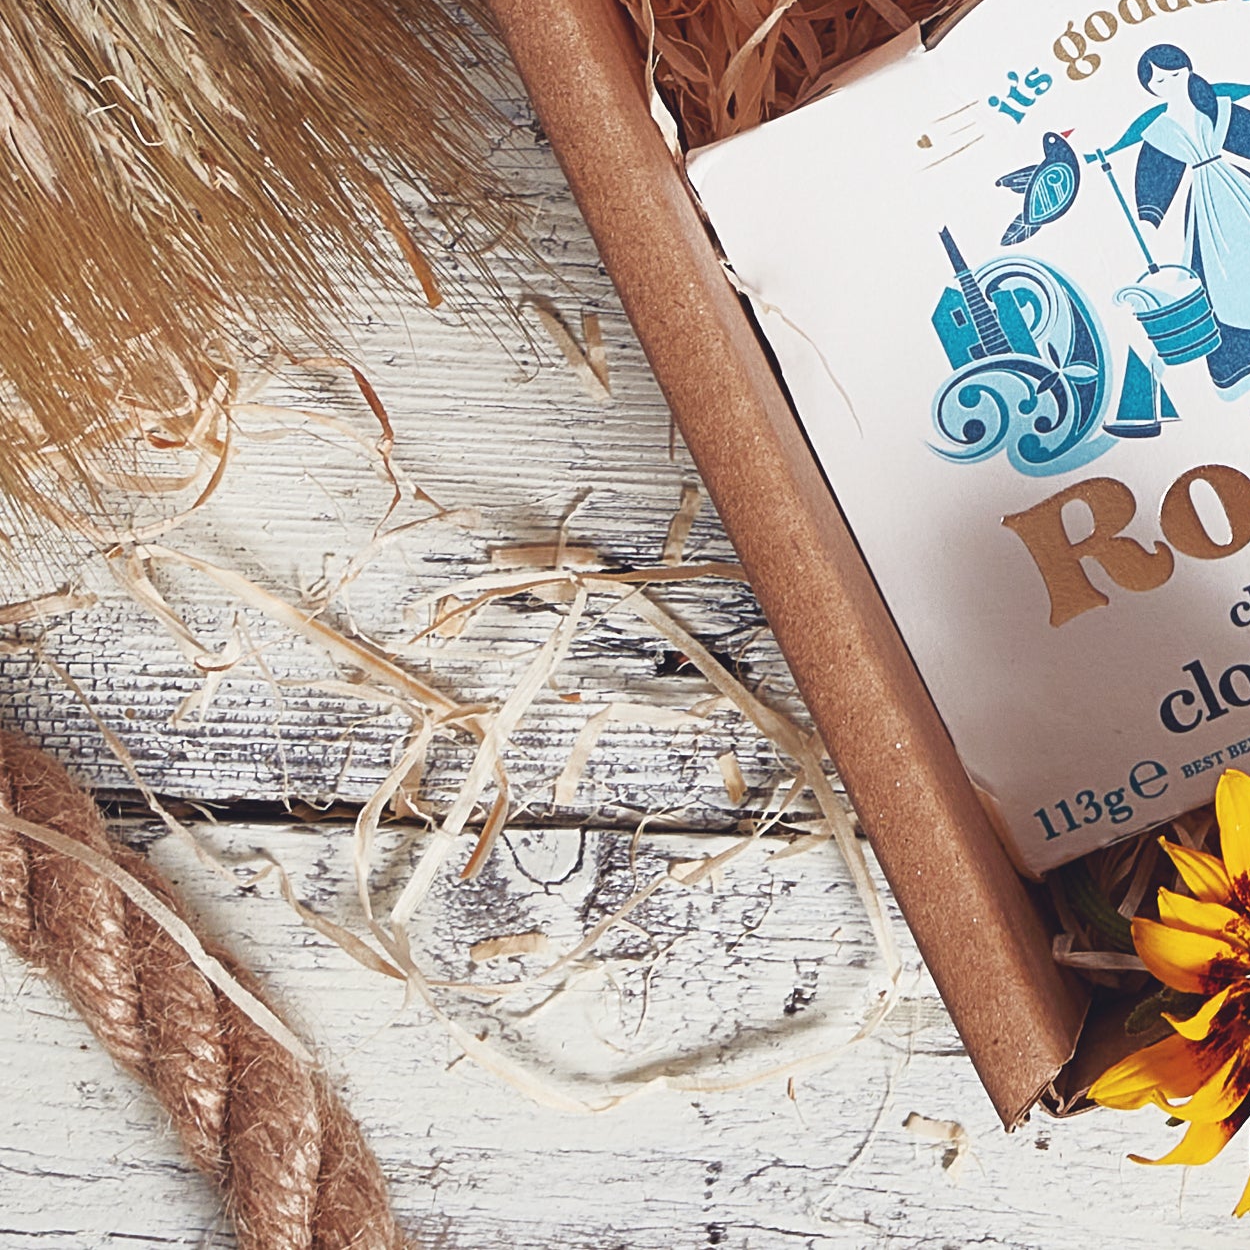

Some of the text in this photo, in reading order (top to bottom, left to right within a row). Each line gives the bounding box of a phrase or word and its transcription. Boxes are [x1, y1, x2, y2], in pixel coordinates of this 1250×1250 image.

[988, 53, 1055, 127] it's
[1033, 787, 1134, 842] 113g
[1181, 747, 1227, 779] BEST
